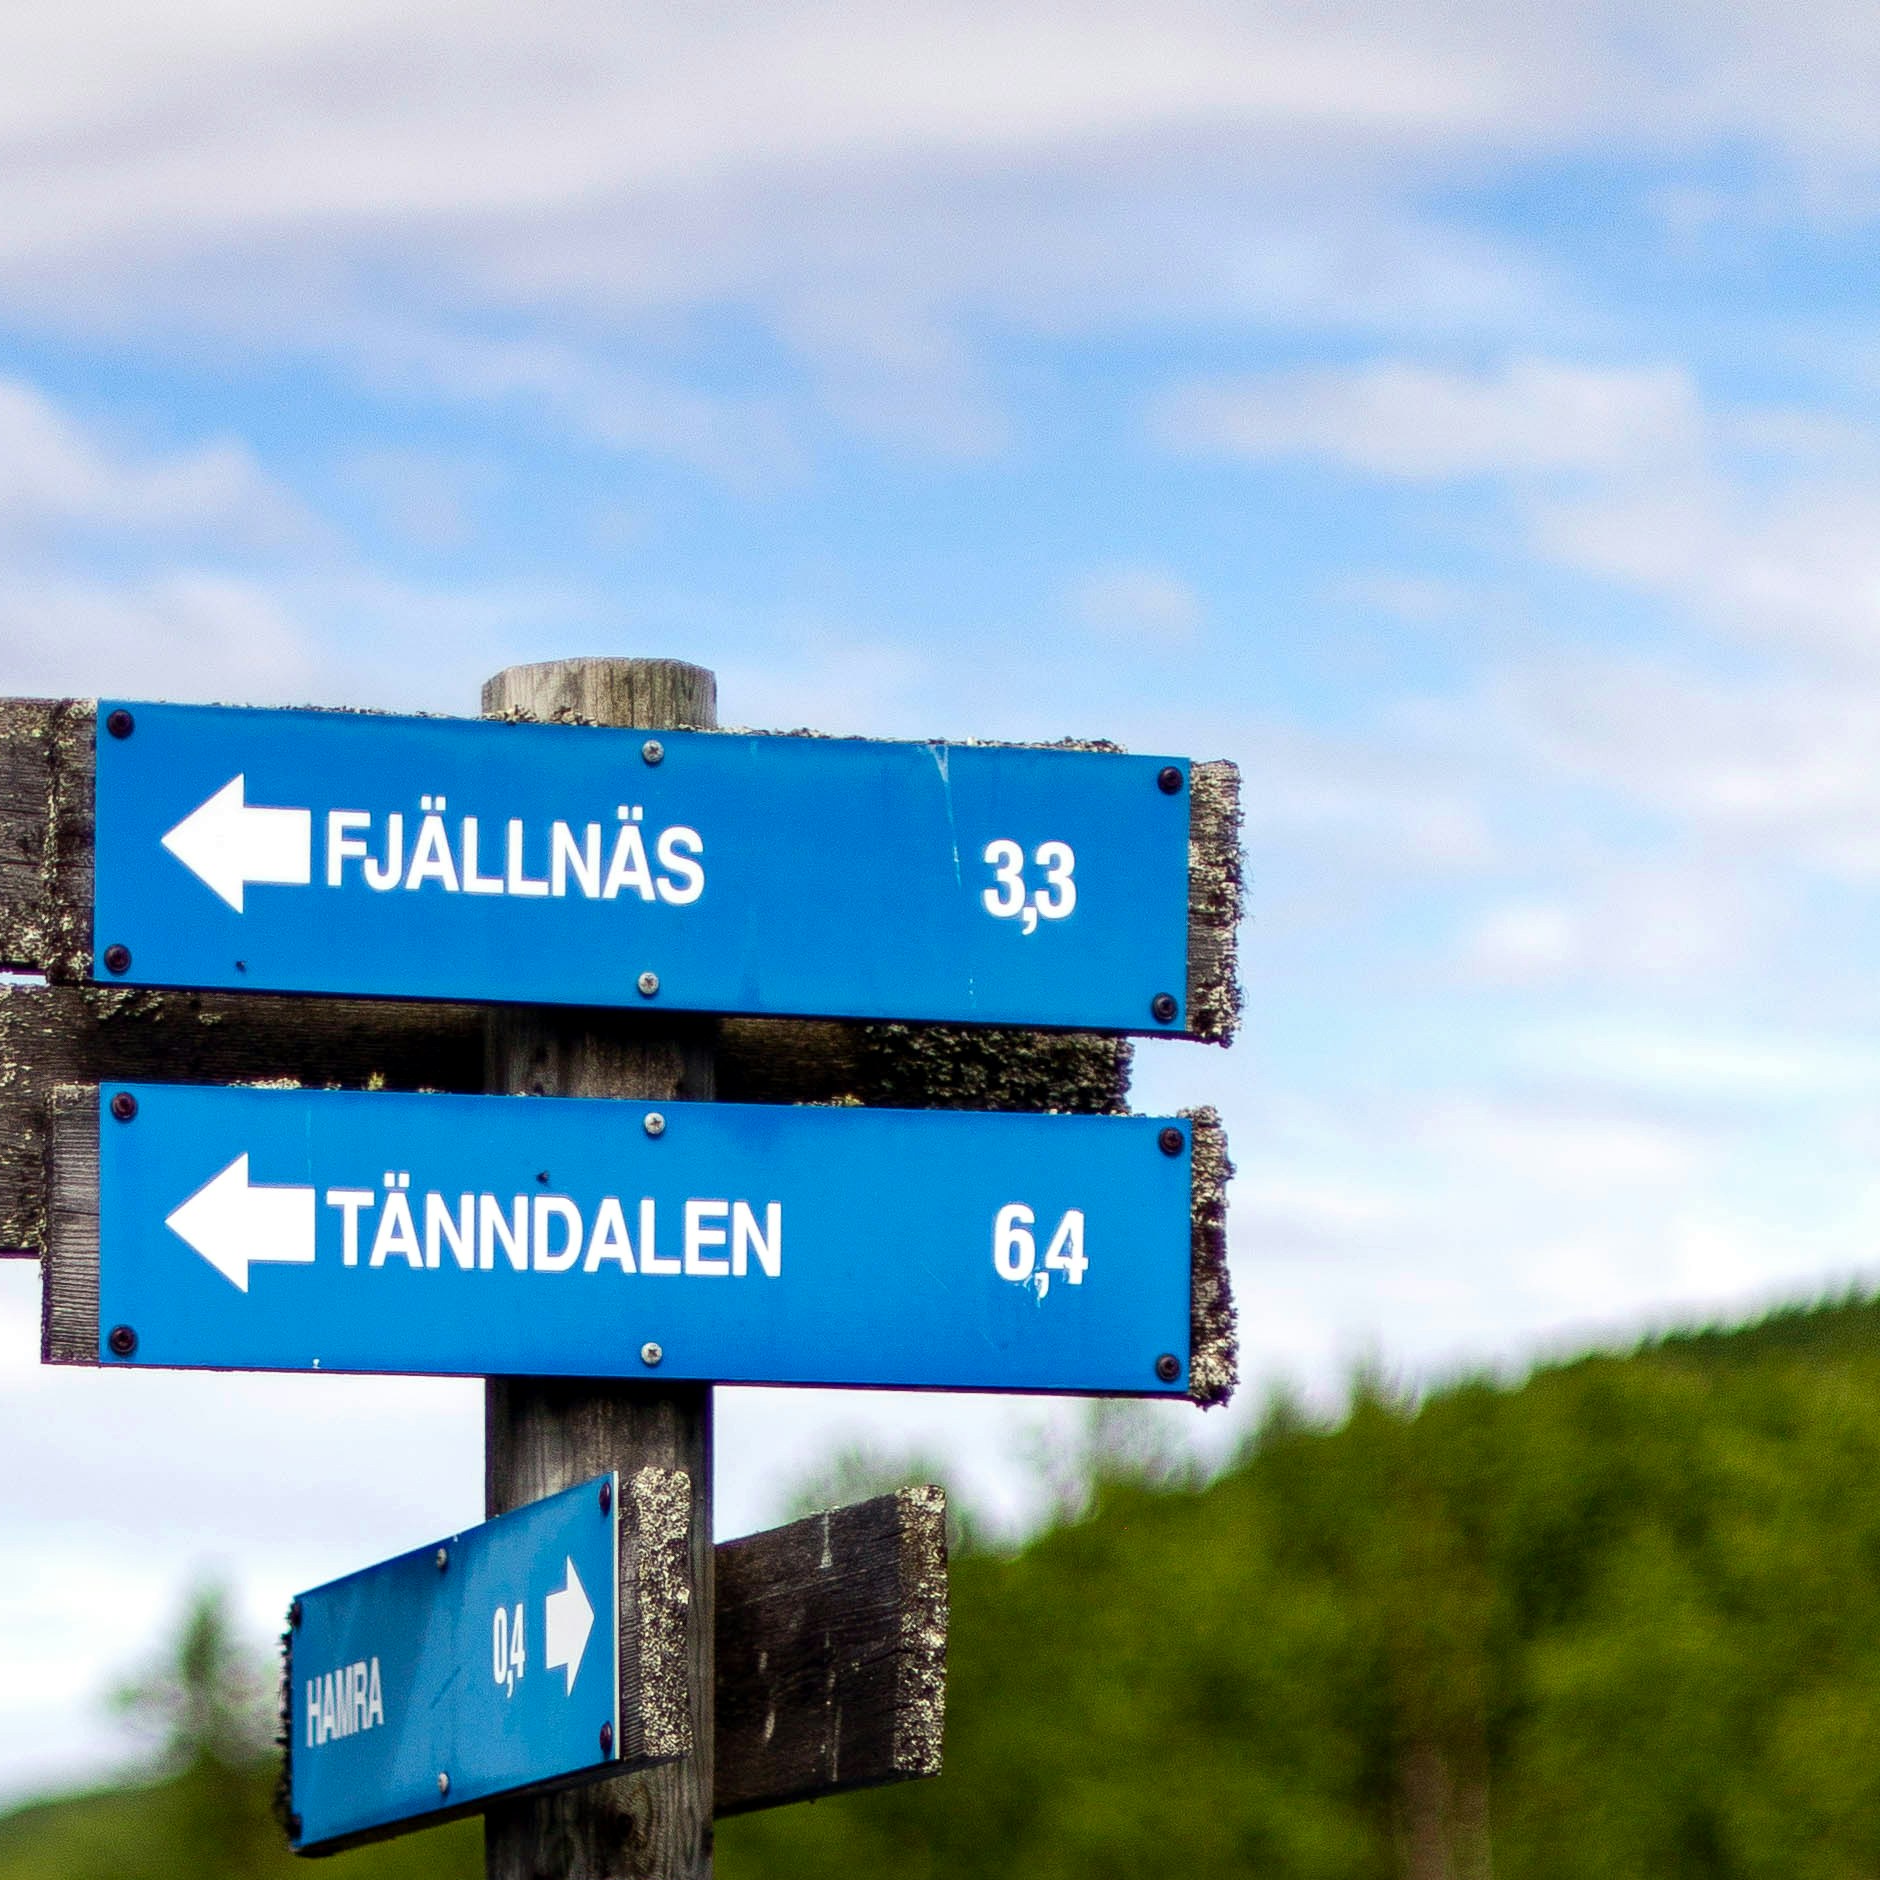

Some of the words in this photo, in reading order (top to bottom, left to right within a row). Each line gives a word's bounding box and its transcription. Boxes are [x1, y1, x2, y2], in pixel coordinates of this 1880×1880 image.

[326, 794, 706, 906] FJÄLLNÄS
[982, 838, 1078, 937] 3,3
[325, 1170, 783, 1278] TÄNNDALEN
[992, 1202, 1090, 1300] 6,4
[306, 1655, 385, 1749] HAMRA
[491, 1601, 527, 1700] 0,4
